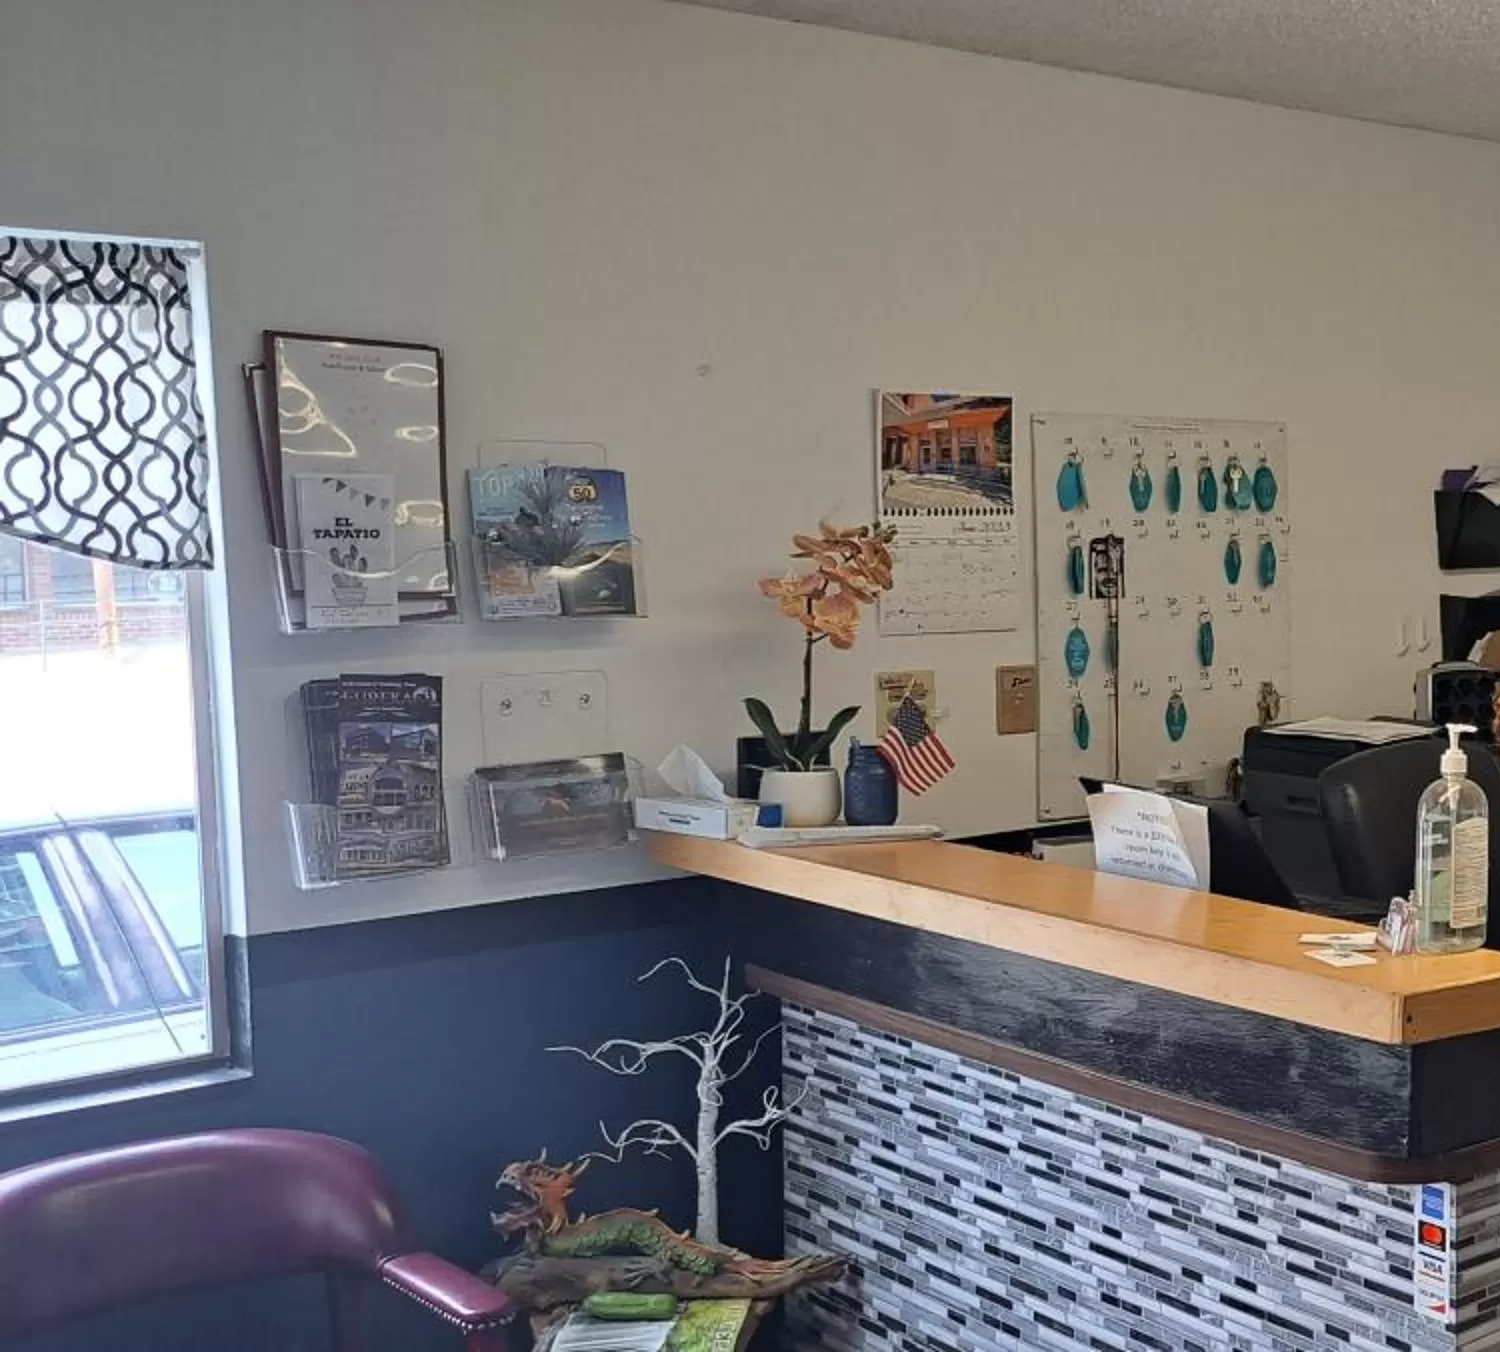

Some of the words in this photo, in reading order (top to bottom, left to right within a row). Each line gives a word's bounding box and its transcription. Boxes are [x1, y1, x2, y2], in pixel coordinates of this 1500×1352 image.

[573, 486, 592, 499] 50
[335, 517, 353, 527] EL
[313, 529, 381, 539] TAPATIO
